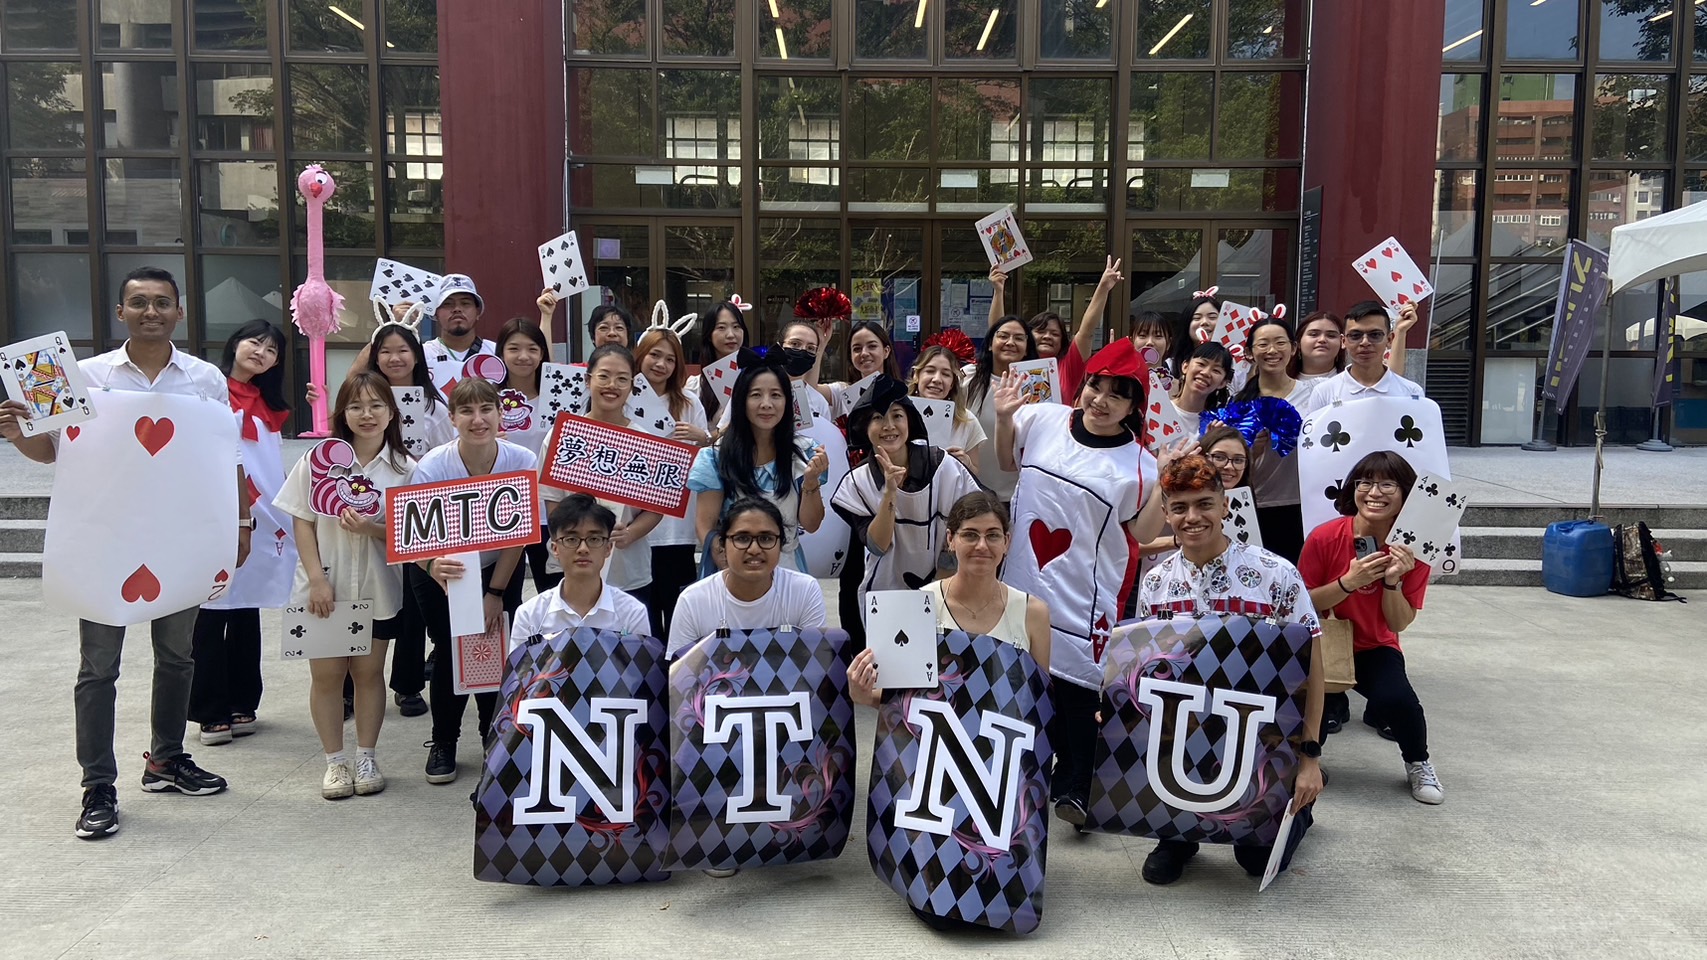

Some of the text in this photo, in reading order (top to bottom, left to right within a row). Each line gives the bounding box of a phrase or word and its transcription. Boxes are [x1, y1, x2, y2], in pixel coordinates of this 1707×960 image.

[1389, 241, 1396, 249] 5
[1357, 262, 1365, 270] 5
[1423, 284, 1430, 292] 5
[55, 336, 63, 345] Q
[0, 352, 7, 361] Q
[636, 377, 644, 385] 5
[843, 391, 849, 399] 3
[82, 405, 90, 415] Q
[945, 404, 951, 412] 2
[26, 421, 34, 431] Q
[1176, 425, 1182, 433] 8
[1302, 418, 1313, 435] 6
[557, 435, 683, 488] 夢想無限
[1421, 475, 1429, 484] 4
[1241, 491, 1249, 500] 10
[1460, 495, 1467, 504] 4
[401, 484, 524, 549] MTC
[1391, 534, 1399, 543] 4
[275, 542, 284, 556] A
[1429, 553, 1437, 562] 4
[830, 562, 841, 575] A
[208, 584, 226, 600] 2
[871, 596, 878, 606] A
[924, 595, 931, 605] A
[1091, 634, 1110, 664] A
[926, 671, 933, 682] A
